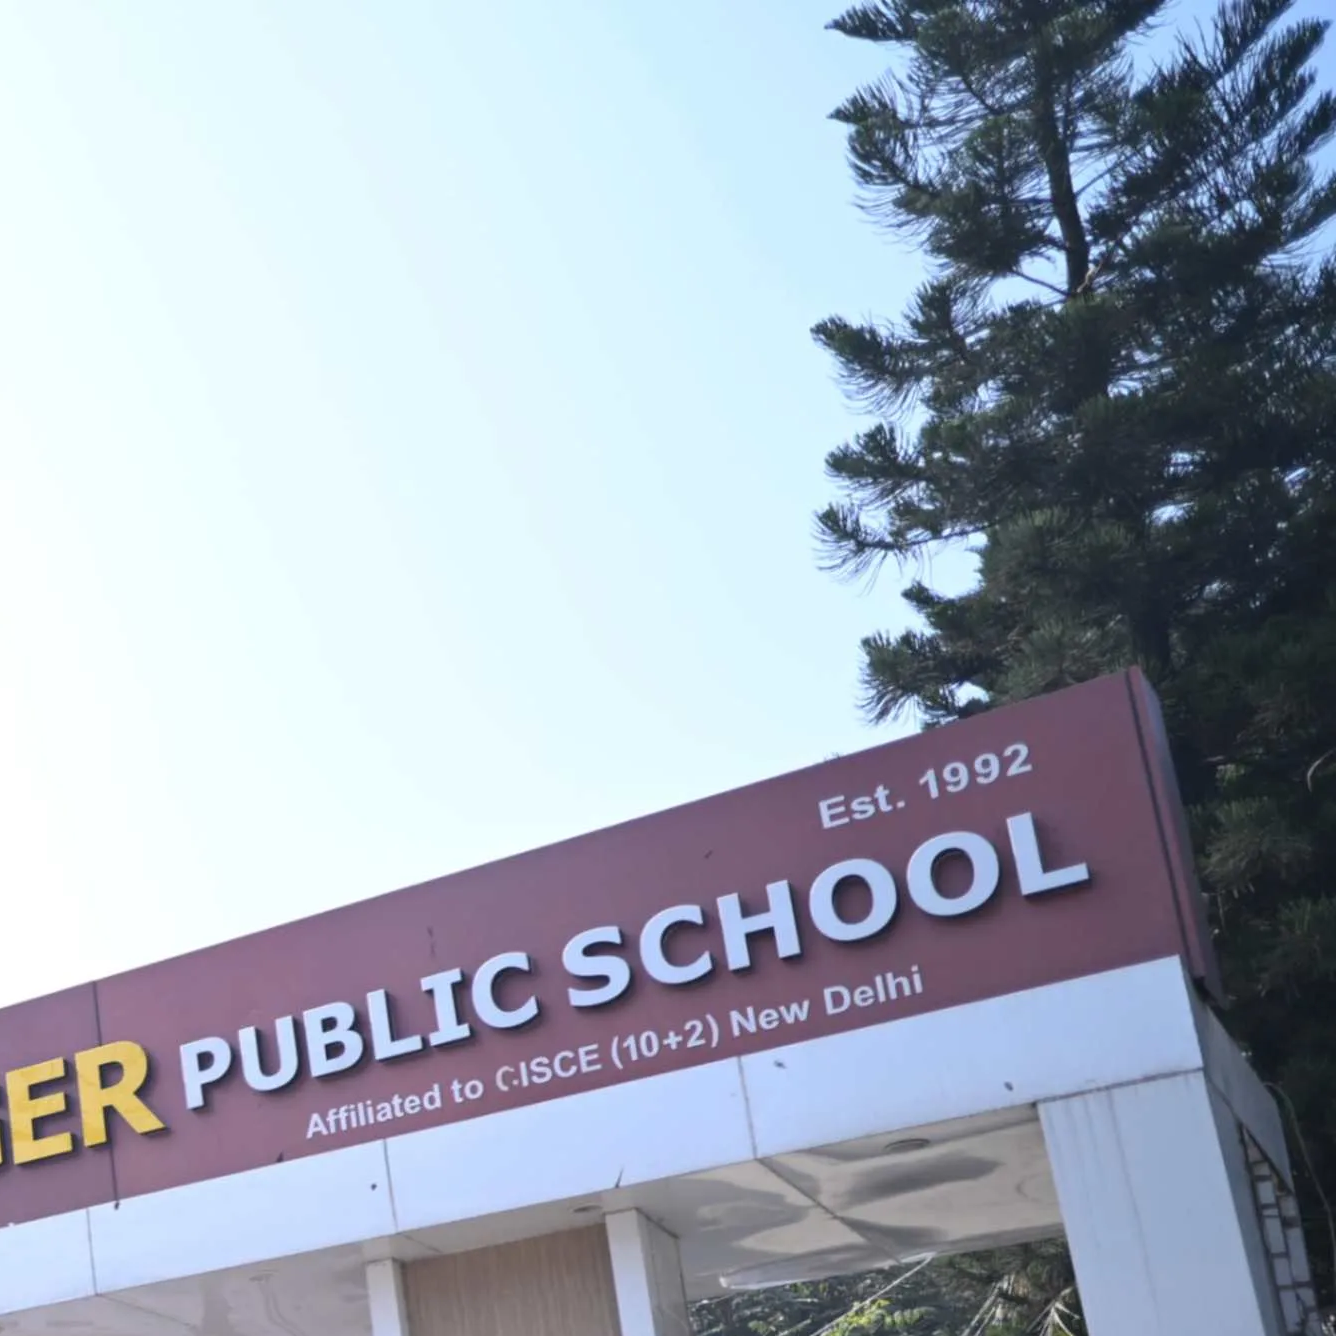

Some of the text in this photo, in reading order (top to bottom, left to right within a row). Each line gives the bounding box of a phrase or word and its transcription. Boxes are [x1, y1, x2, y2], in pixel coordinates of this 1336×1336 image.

[817, 741, 1033, 830] Est. 1992
[179, 952, 541, 1111] PUBLIC
[561, 811, 1091, 1008] SCHOOL
[305, 1083, 443, 1139] Affiliated
[450, 1077, 484, 1104] to
[610, 1013, 720, 1070] (10+2)
[729, 998, 811, 1038] New
[822, 964, 924, 1016] Delhi
